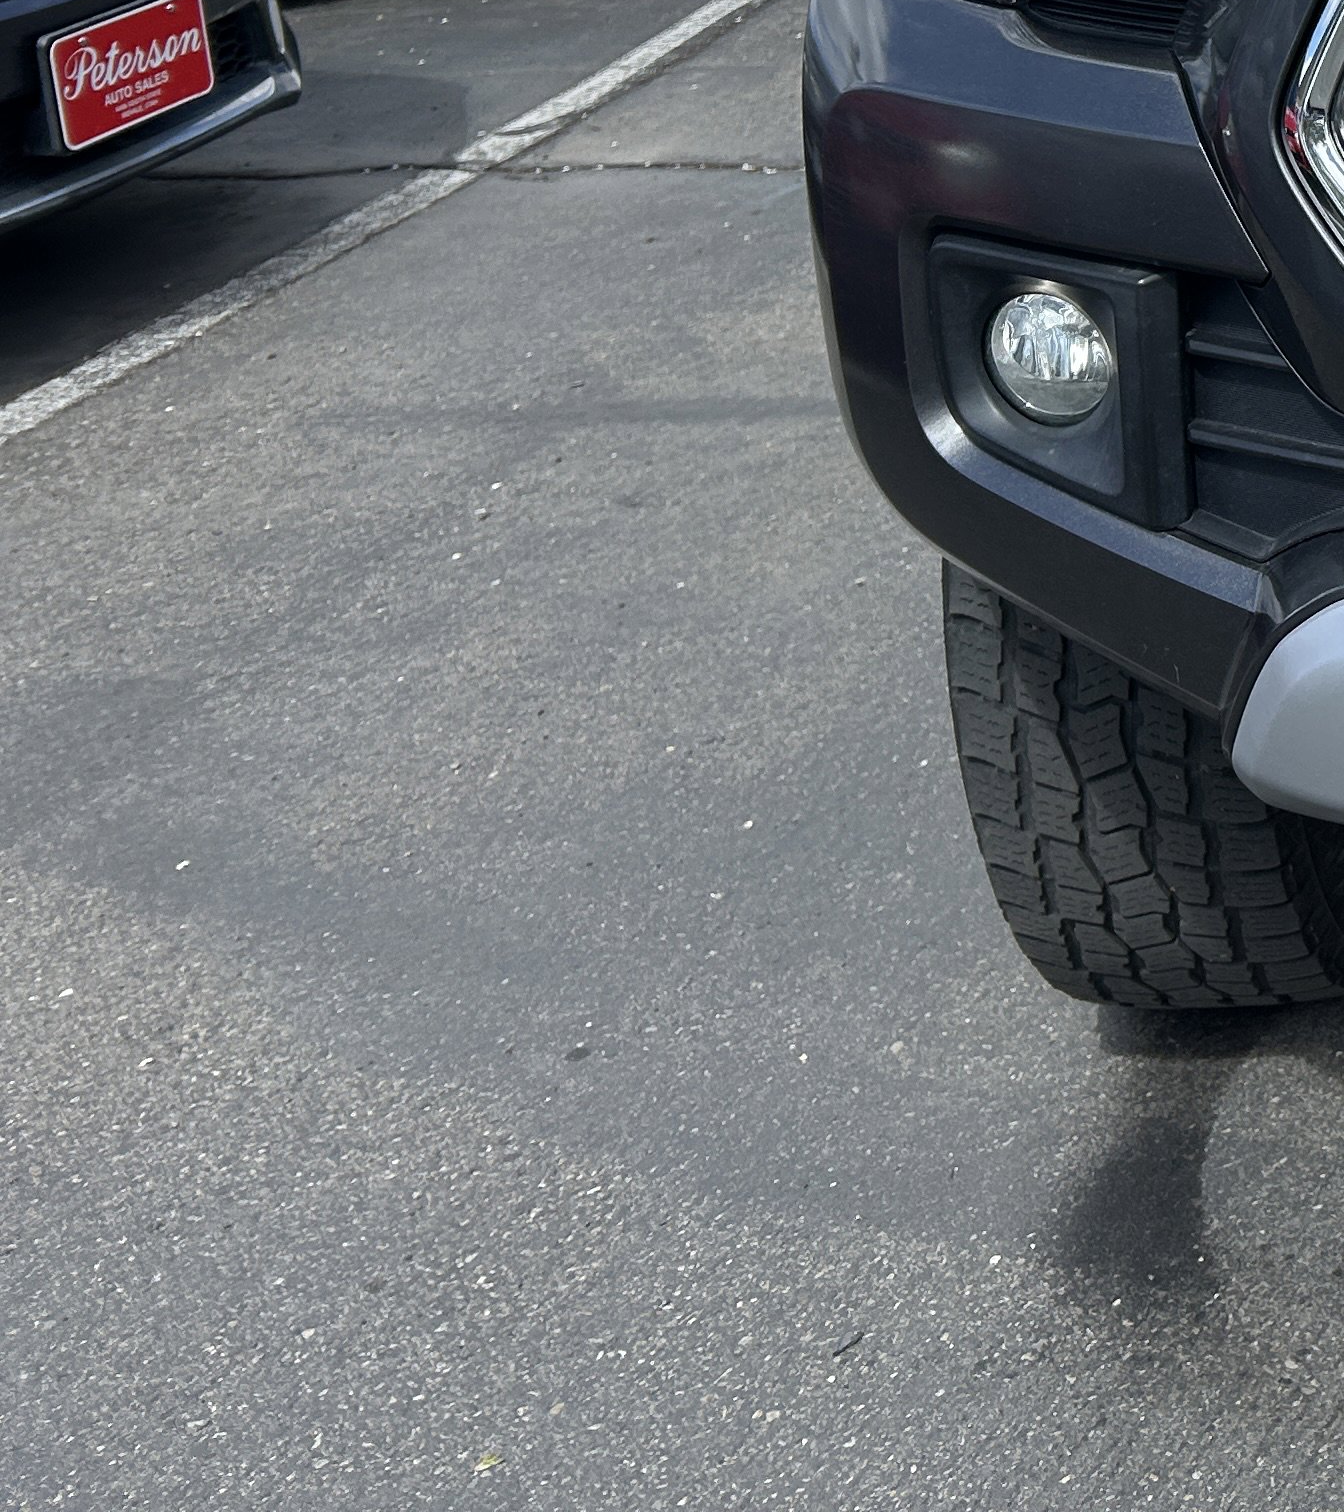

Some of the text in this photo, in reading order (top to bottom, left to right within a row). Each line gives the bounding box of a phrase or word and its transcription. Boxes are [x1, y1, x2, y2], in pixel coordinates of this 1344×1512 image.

[64, 27, 202, 100] Peterson
[104, 85, 133, 106] AUTO
[134, 70, 170, 94] SALES
